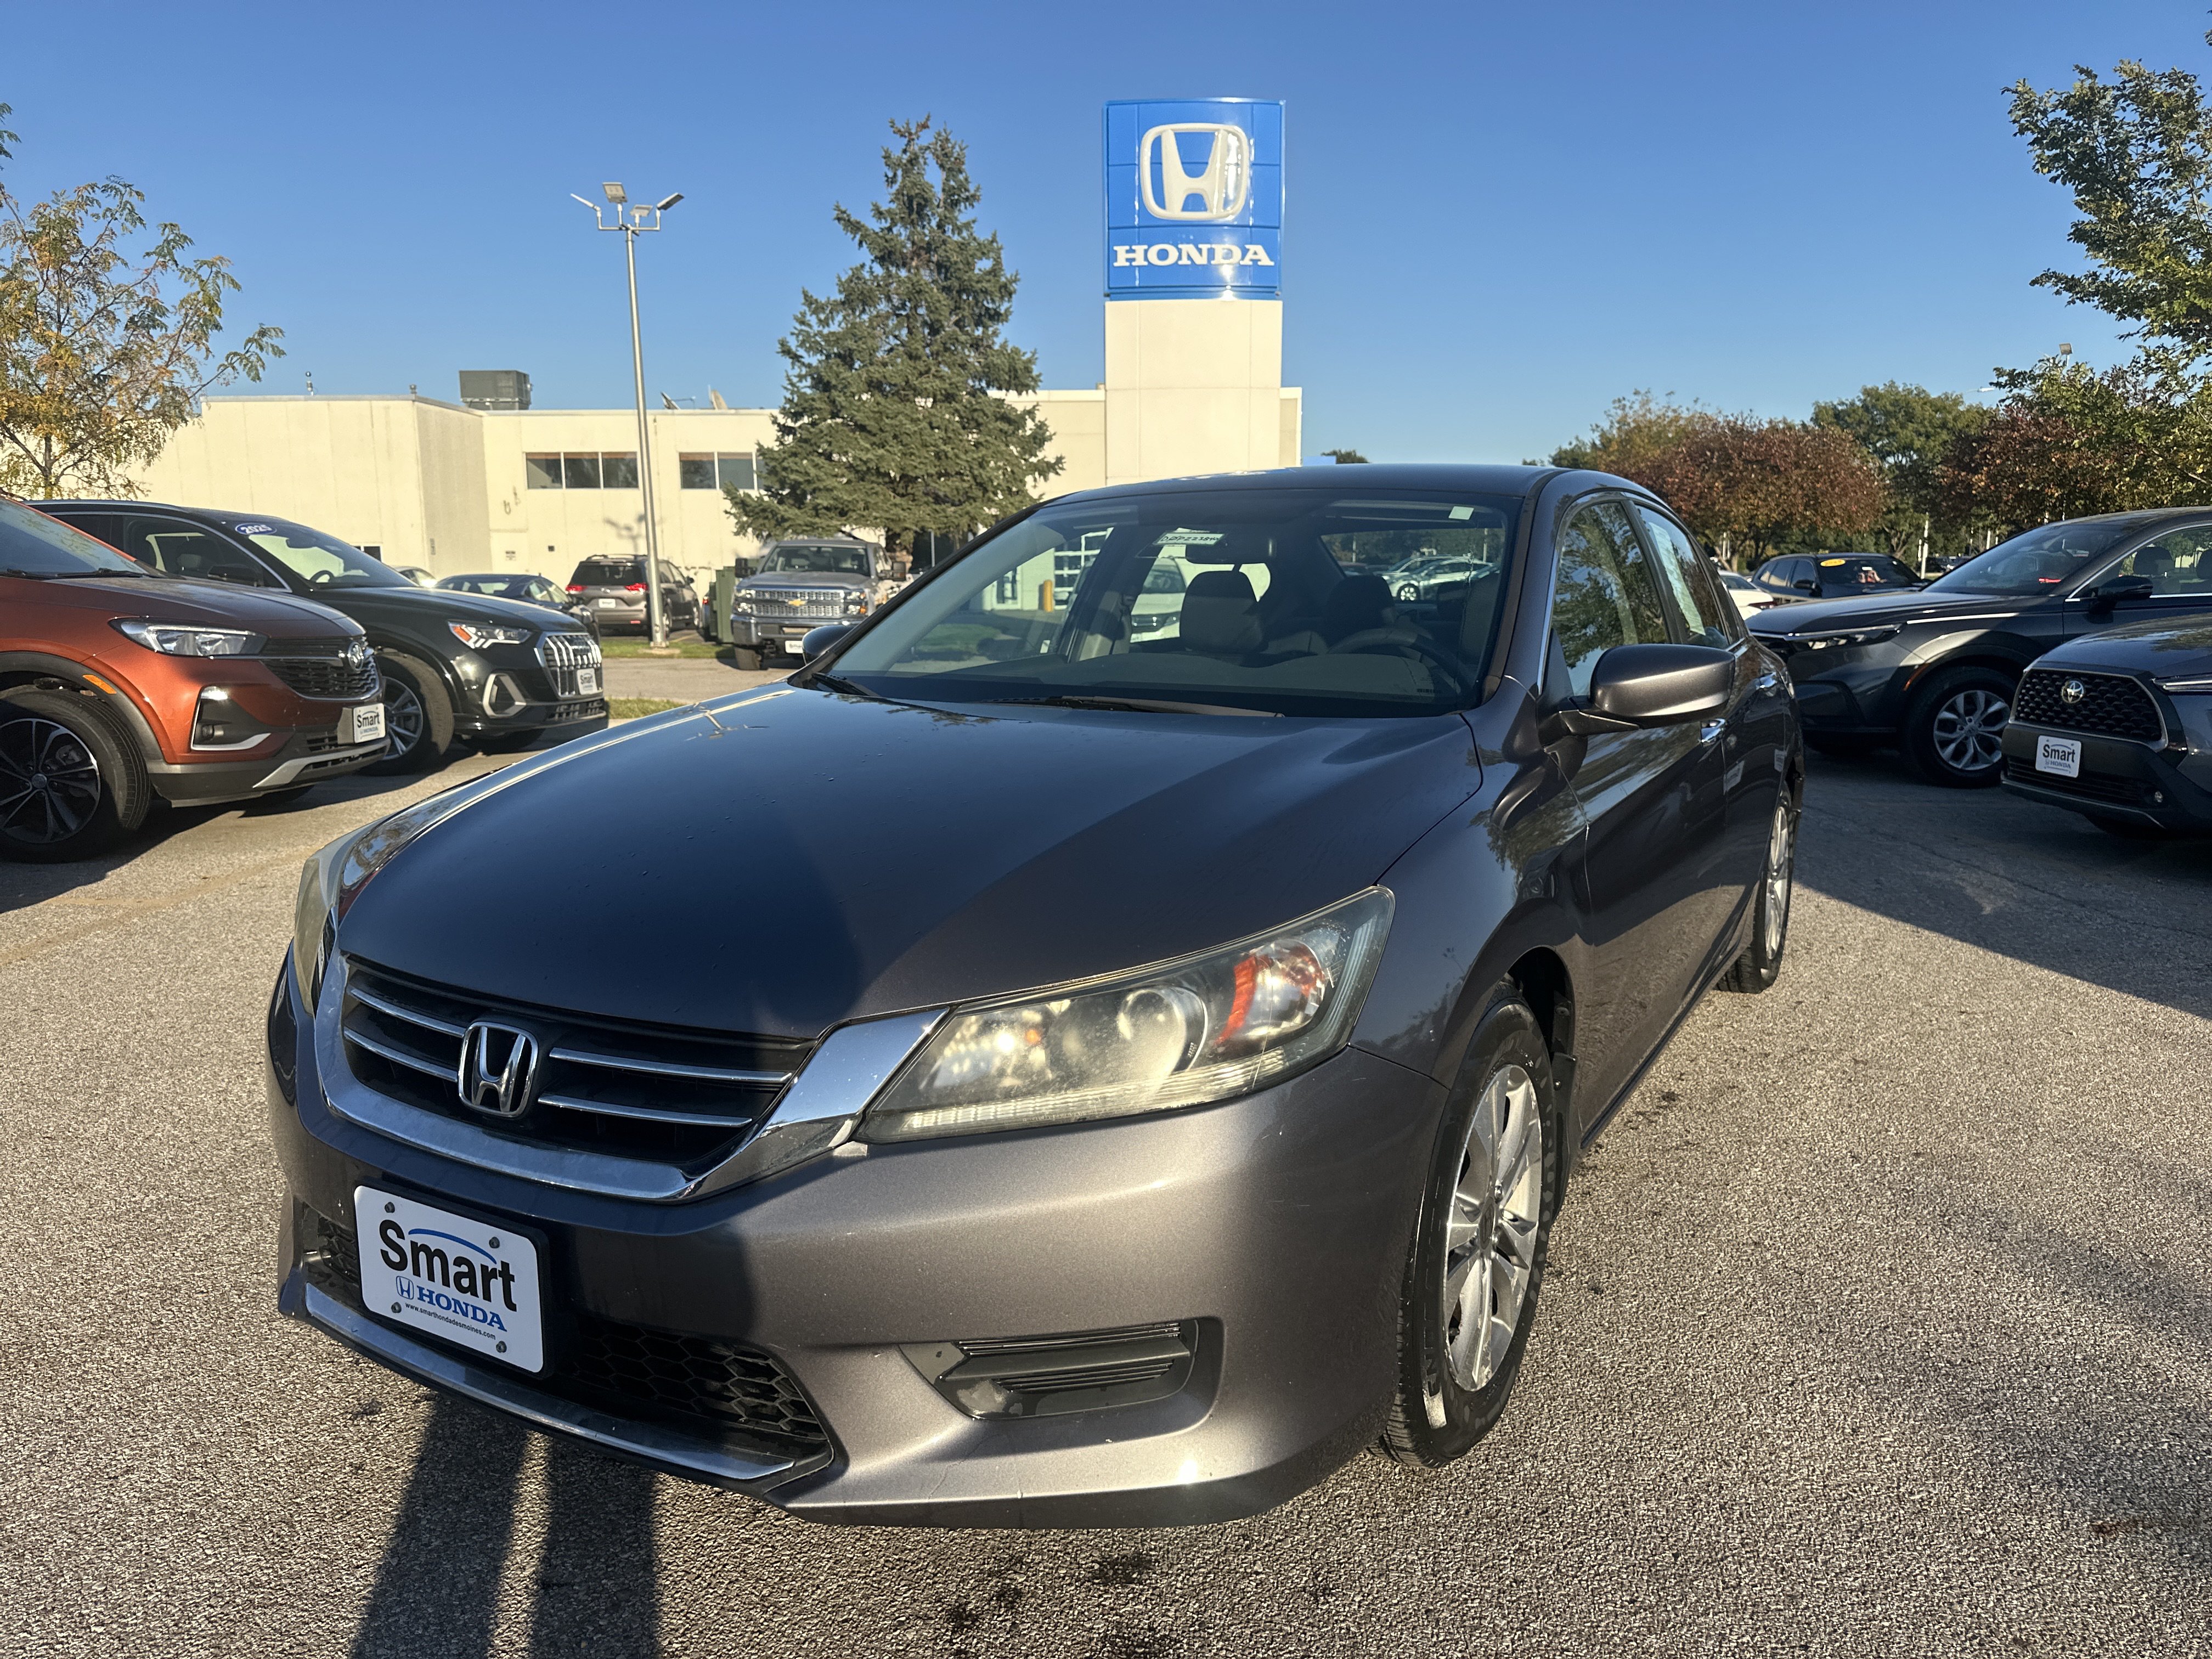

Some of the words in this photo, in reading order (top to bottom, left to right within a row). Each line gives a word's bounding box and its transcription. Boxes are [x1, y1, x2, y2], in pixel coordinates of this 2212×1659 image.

[1113, 244, 1275, 267] HONDA
[240, 524, 273, 534] 2025
[357, 712, 380, 728] Smart
[2042, 744, 2075, 763] Smart
[2051, 760, 2072, 769] HONDA
[379, 1219, 517, 1312] Smart
[416, 1285, 507, 1332] HONDA
[405, 1302, 496, 1340] www.smarthondadesmoines.com
